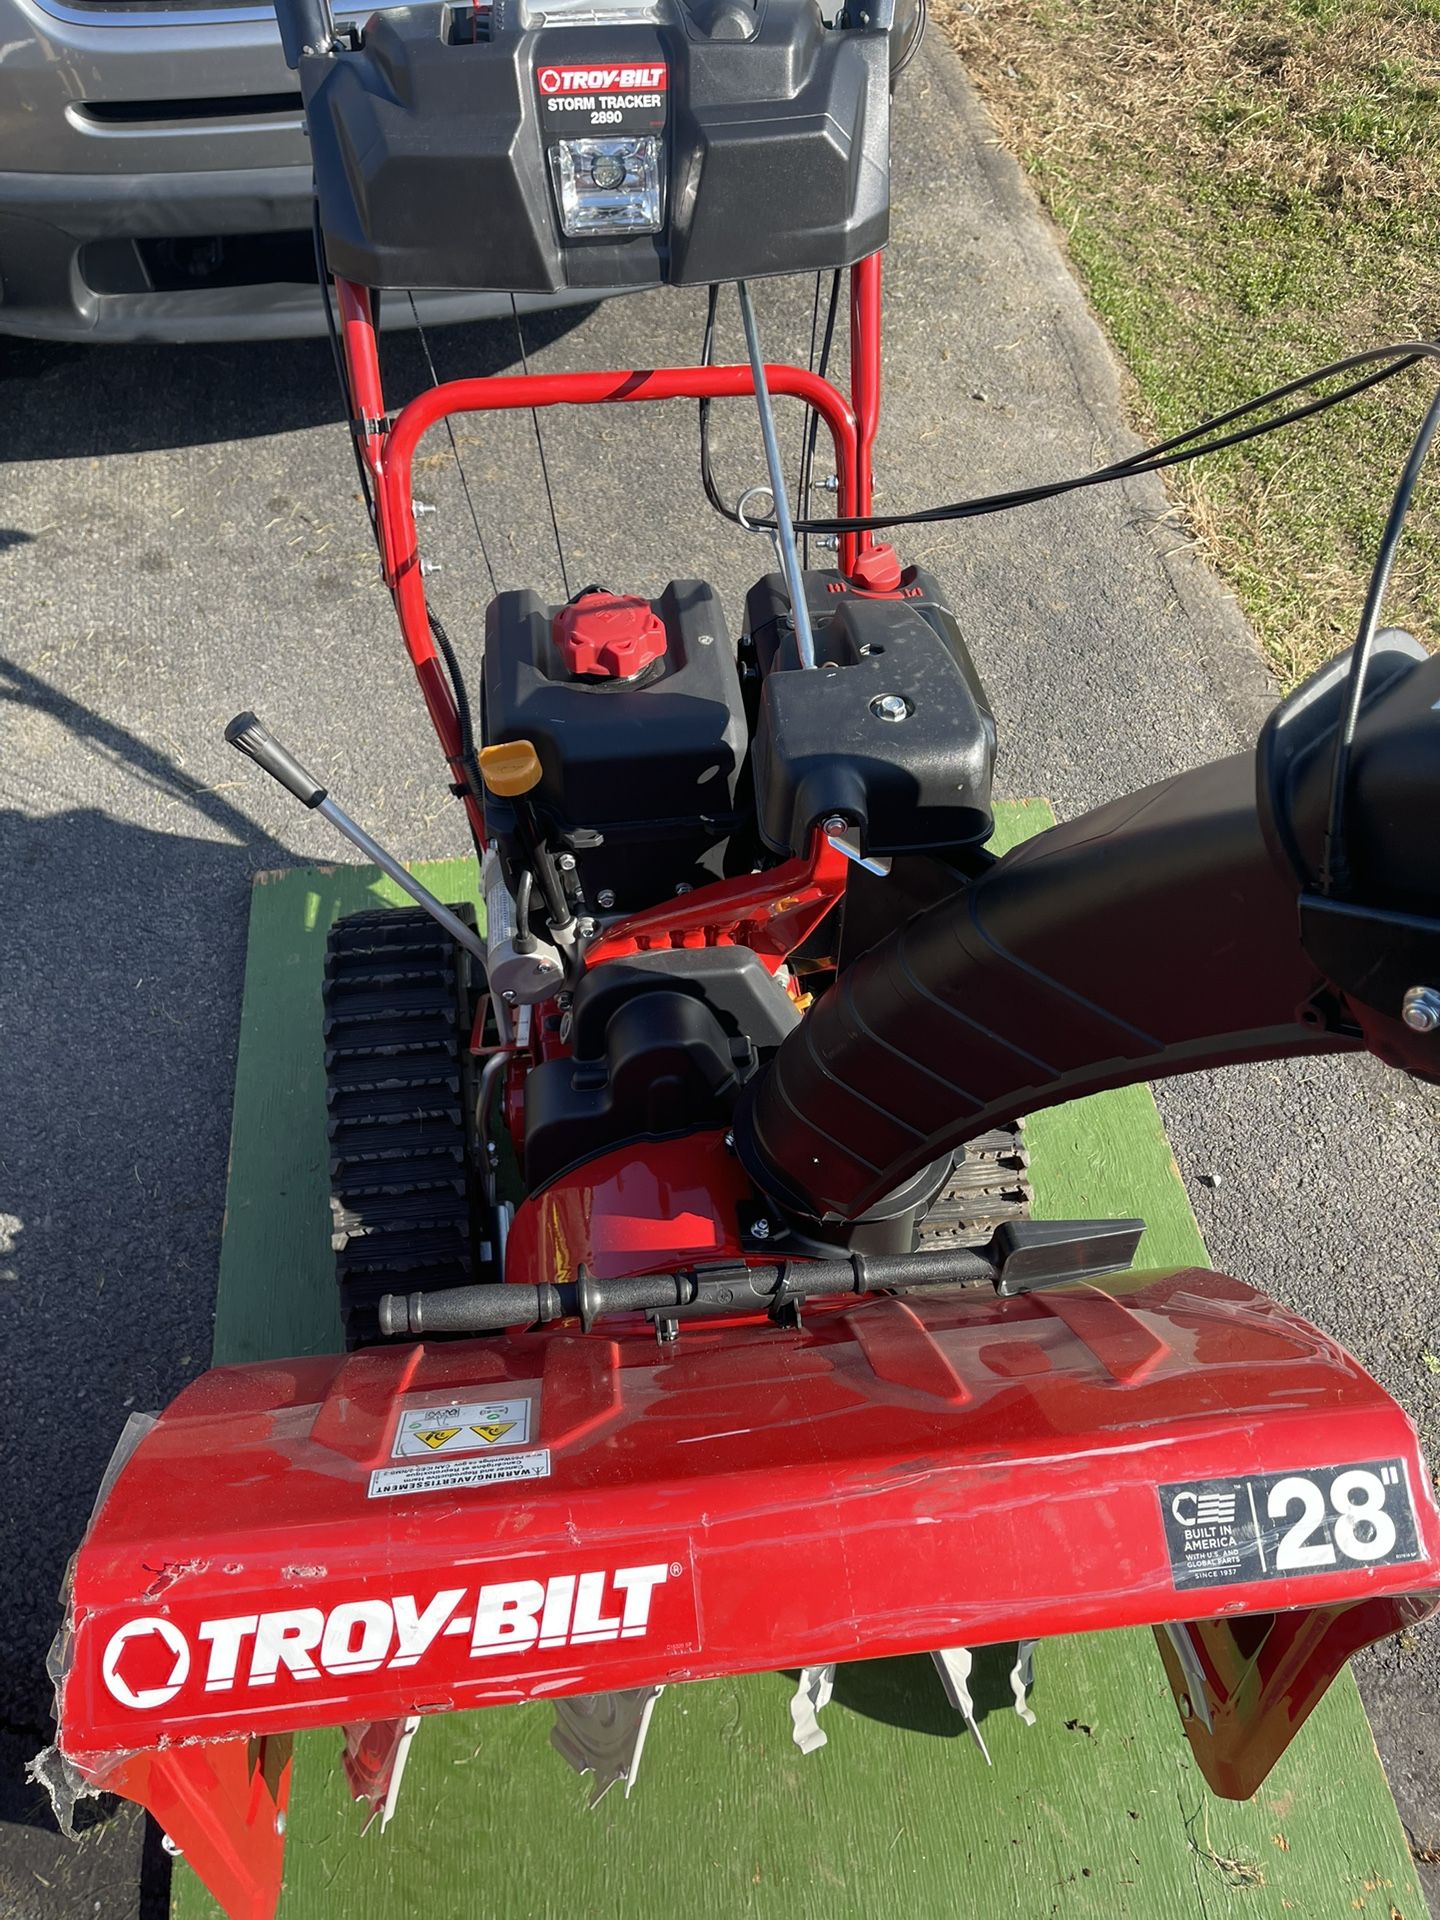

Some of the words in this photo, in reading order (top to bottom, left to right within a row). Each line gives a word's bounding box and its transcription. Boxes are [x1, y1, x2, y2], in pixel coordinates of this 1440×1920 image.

[561, 69, 663, 90] TROY-BILT
[548, 97, 595, 111] STORM
[599, 94, 661, 110] TRACKER
[590, 111, 622, 124] 2890
[376, 1468, 530, 1493] WARNING/AVERTISSEMENT
[425, 1469, 477, 1480] Reproductive
[1184, 1528, 1217, 1540] BUILT
[1219, 1525, 1232, 1537] IN
[1184, 1536, 1237, 1552] AMERICA
[1186, 1553, 1206, 1561] WITH
[1223, 1549, 1239, 1558] AND
[1187, 1560, 1216, 1568] GLOBAL
[1194, 1571, 1218, 1580] SINCE
[1220, 1568, 1237, 1576] 1937
